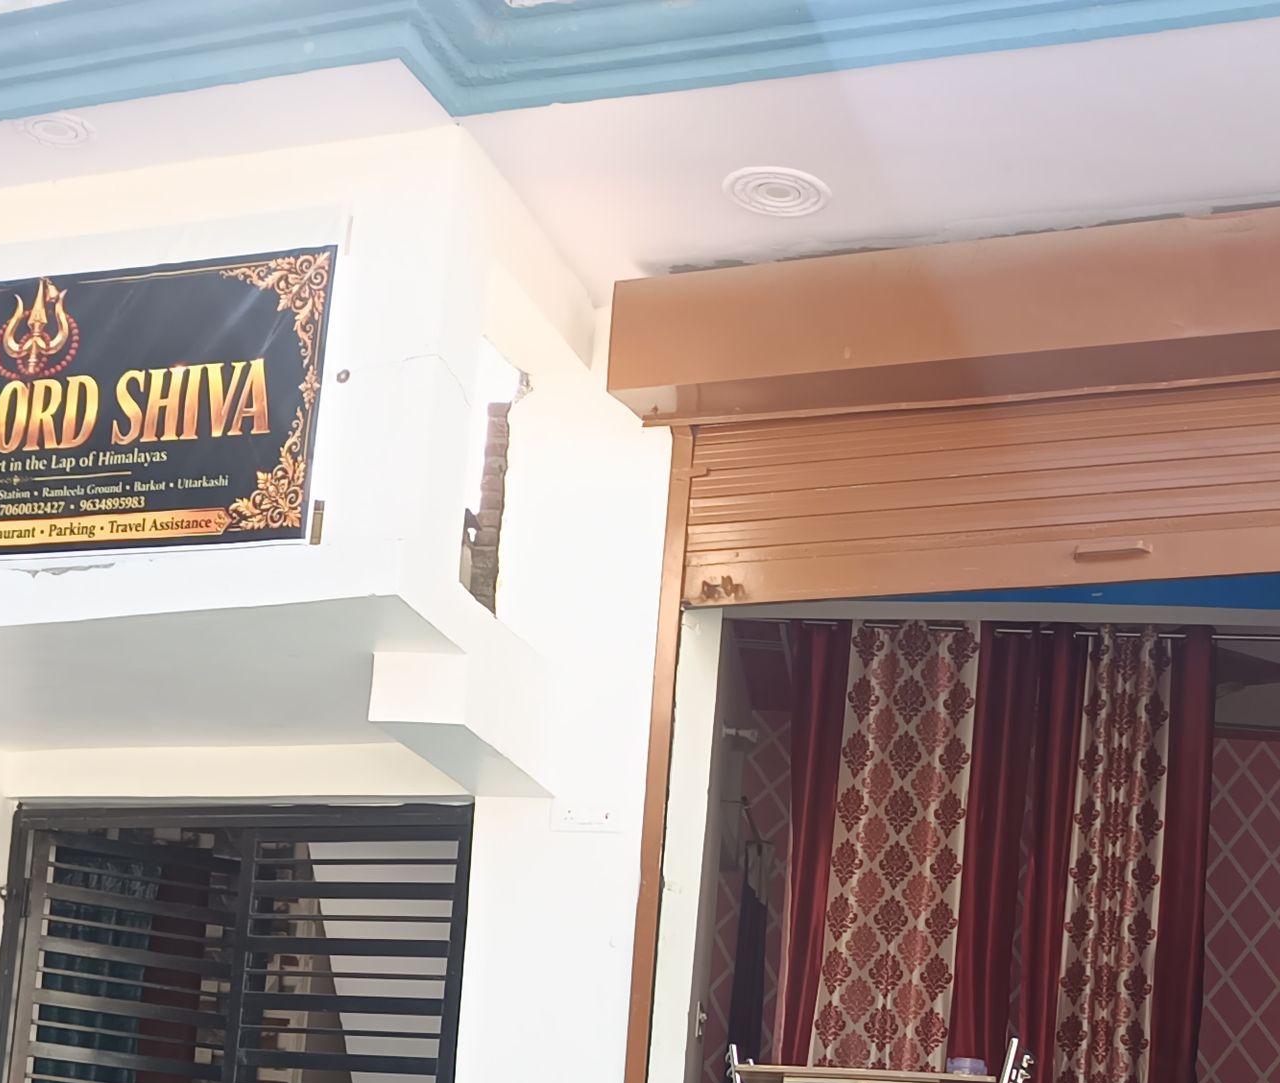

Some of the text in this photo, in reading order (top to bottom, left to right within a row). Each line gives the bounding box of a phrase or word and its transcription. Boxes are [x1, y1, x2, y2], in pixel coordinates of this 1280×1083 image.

[111, 358, 270, 445] SHIVA
[10, 458, 22, 471] in
[26, 455, 47, 470] the
[51, 455, 75, 472] Lap
[79, 451, 97, 467] of
[98, 448, 167, 467] Himalayas
[86, 483, 122, 495] Ground
[134, 480, 166, 492] Barkot
[177, 475, 229, 489] Uttarkashi
[0, 501, 65, 516] 7060032427
[80, 496, 145, 511] 9634895983
[48, 522, 96, 538] Parking
[108, 518, 146, 534] Travel
[149, 516, 212, 532] Assistance
